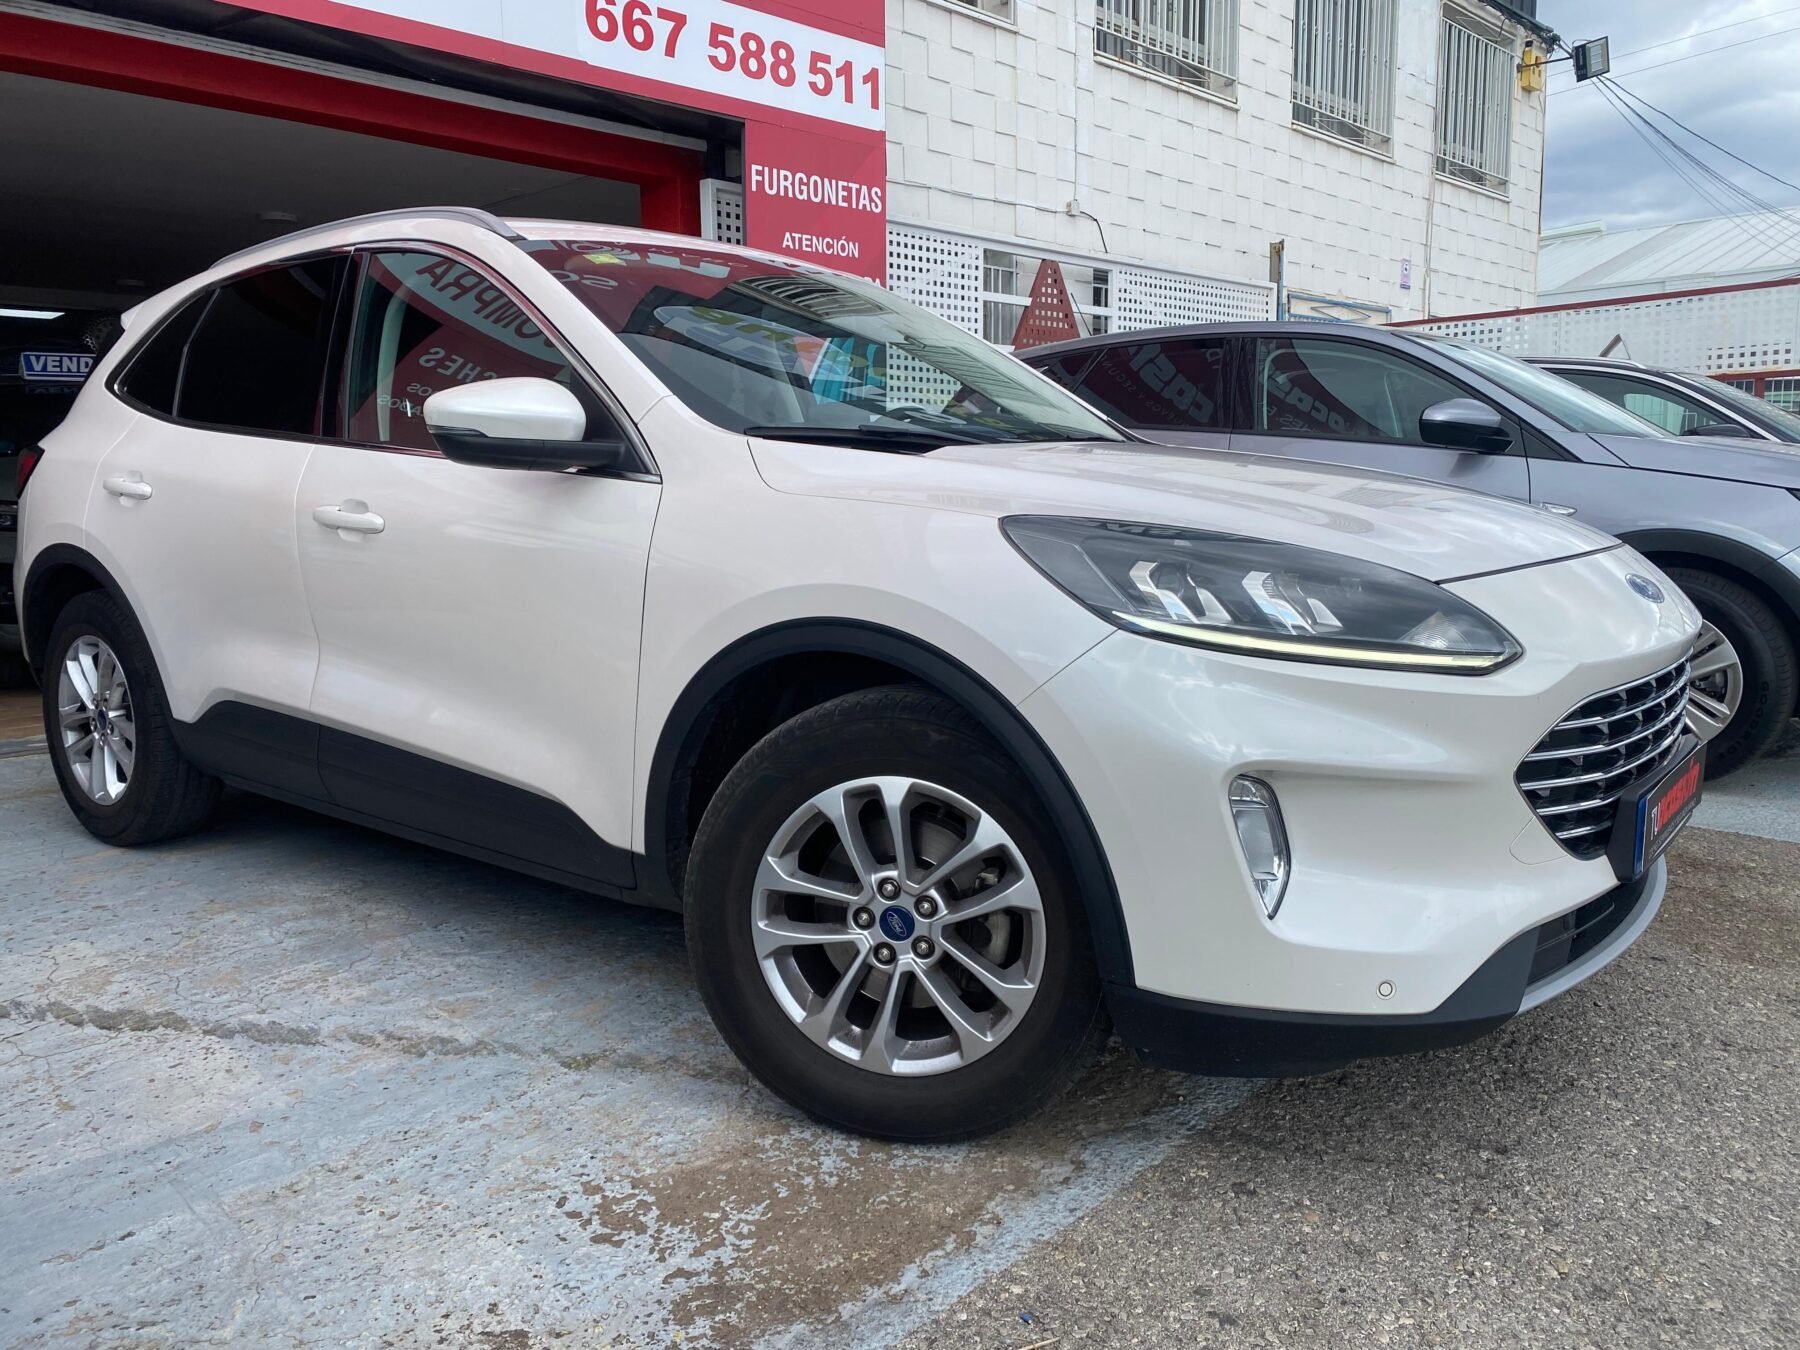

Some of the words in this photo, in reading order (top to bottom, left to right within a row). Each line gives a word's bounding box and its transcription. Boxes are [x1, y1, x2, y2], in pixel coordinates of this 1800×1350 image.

[585, 0, 687, 58] 667
[707, 22, 796, 87] 588
[808, 50, 880, 111] 511
[751, 164, 882, 214] FURGONETAS
[782, 231, 859, 259] ATENCIÓN
